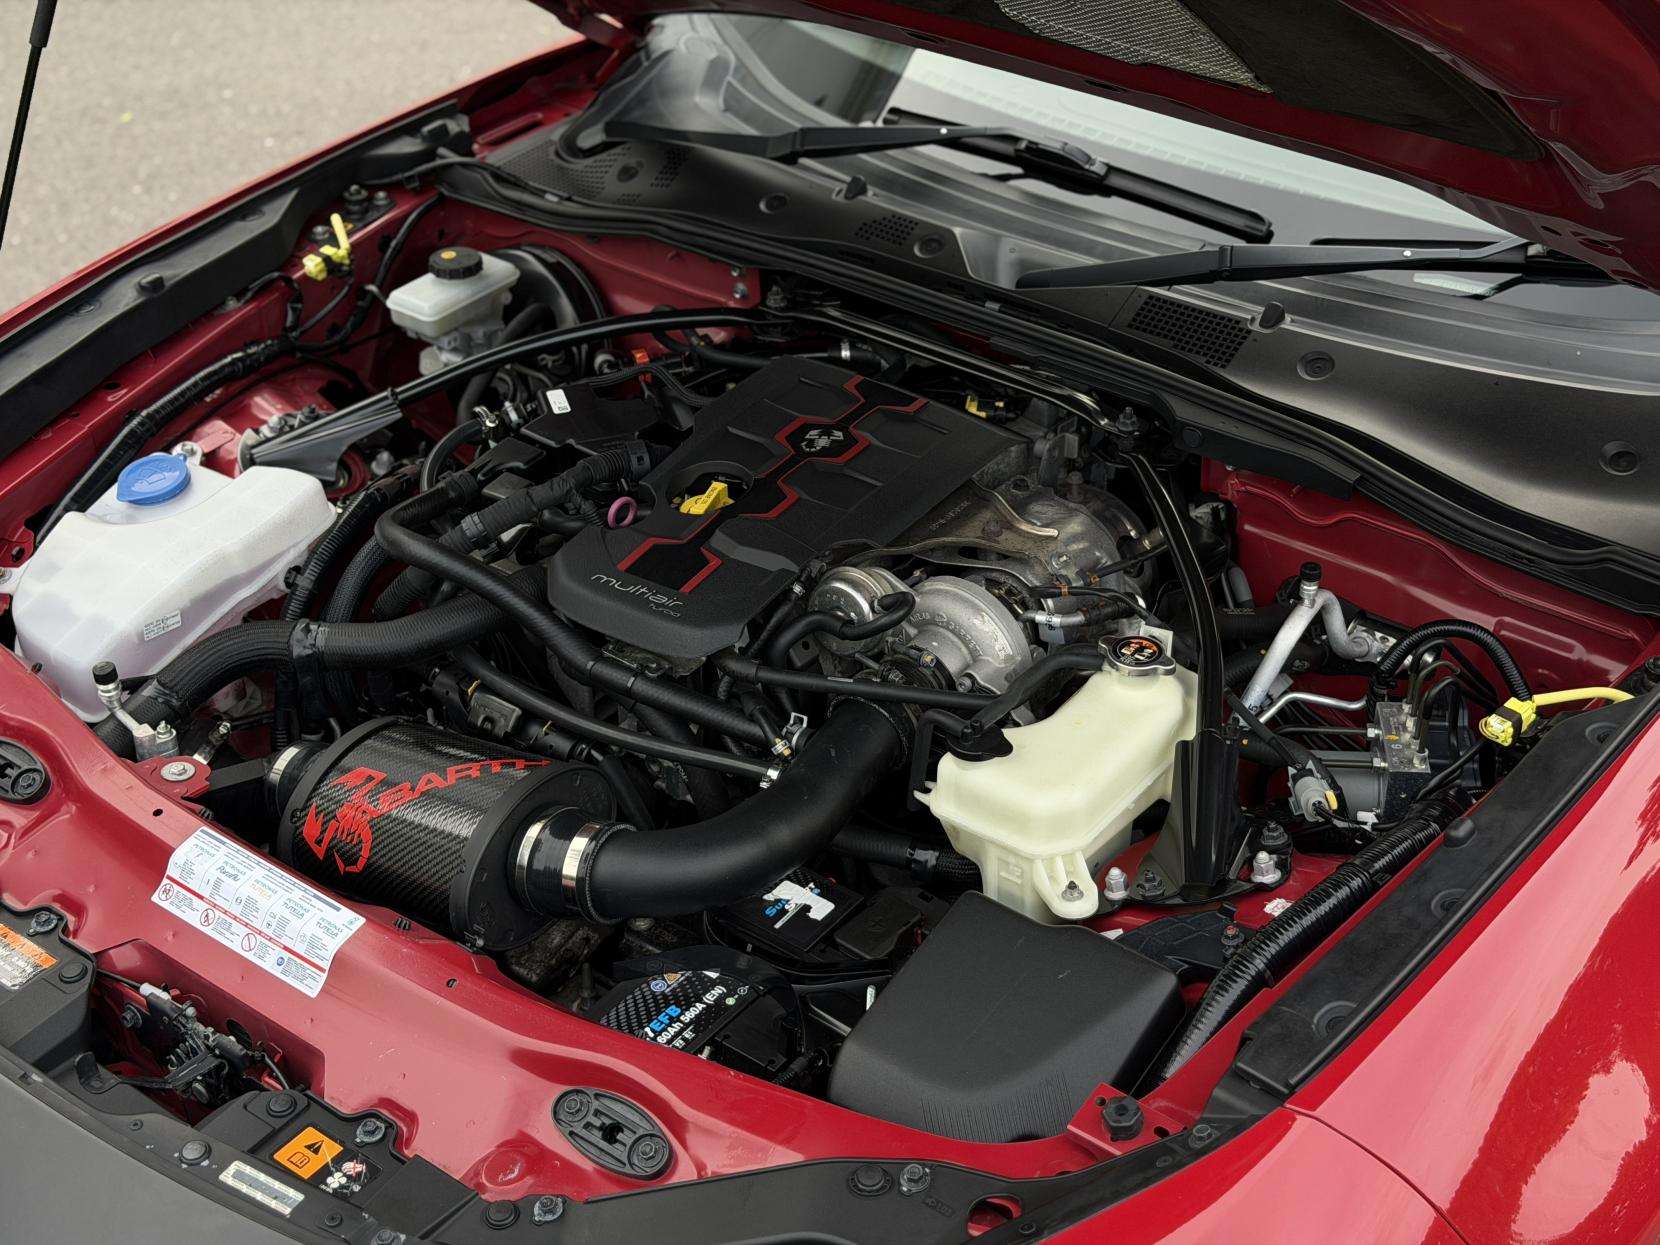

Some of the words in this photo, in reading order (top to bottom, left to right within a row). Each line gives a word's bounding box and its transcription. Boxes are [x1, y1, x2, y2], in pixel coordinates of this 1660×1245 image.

[590, 573, 684, 607] multiair
[282, 902, 305, 918] TUTELA
[315, 921, 340, 937] TUTELA
[649, 1004, 681, 1032] EFB
[656, 1021, 683, 1043] 60Ah
[680, 1002, 706, 1023] 560A
[702, 985, 727, 1004] (EN)
